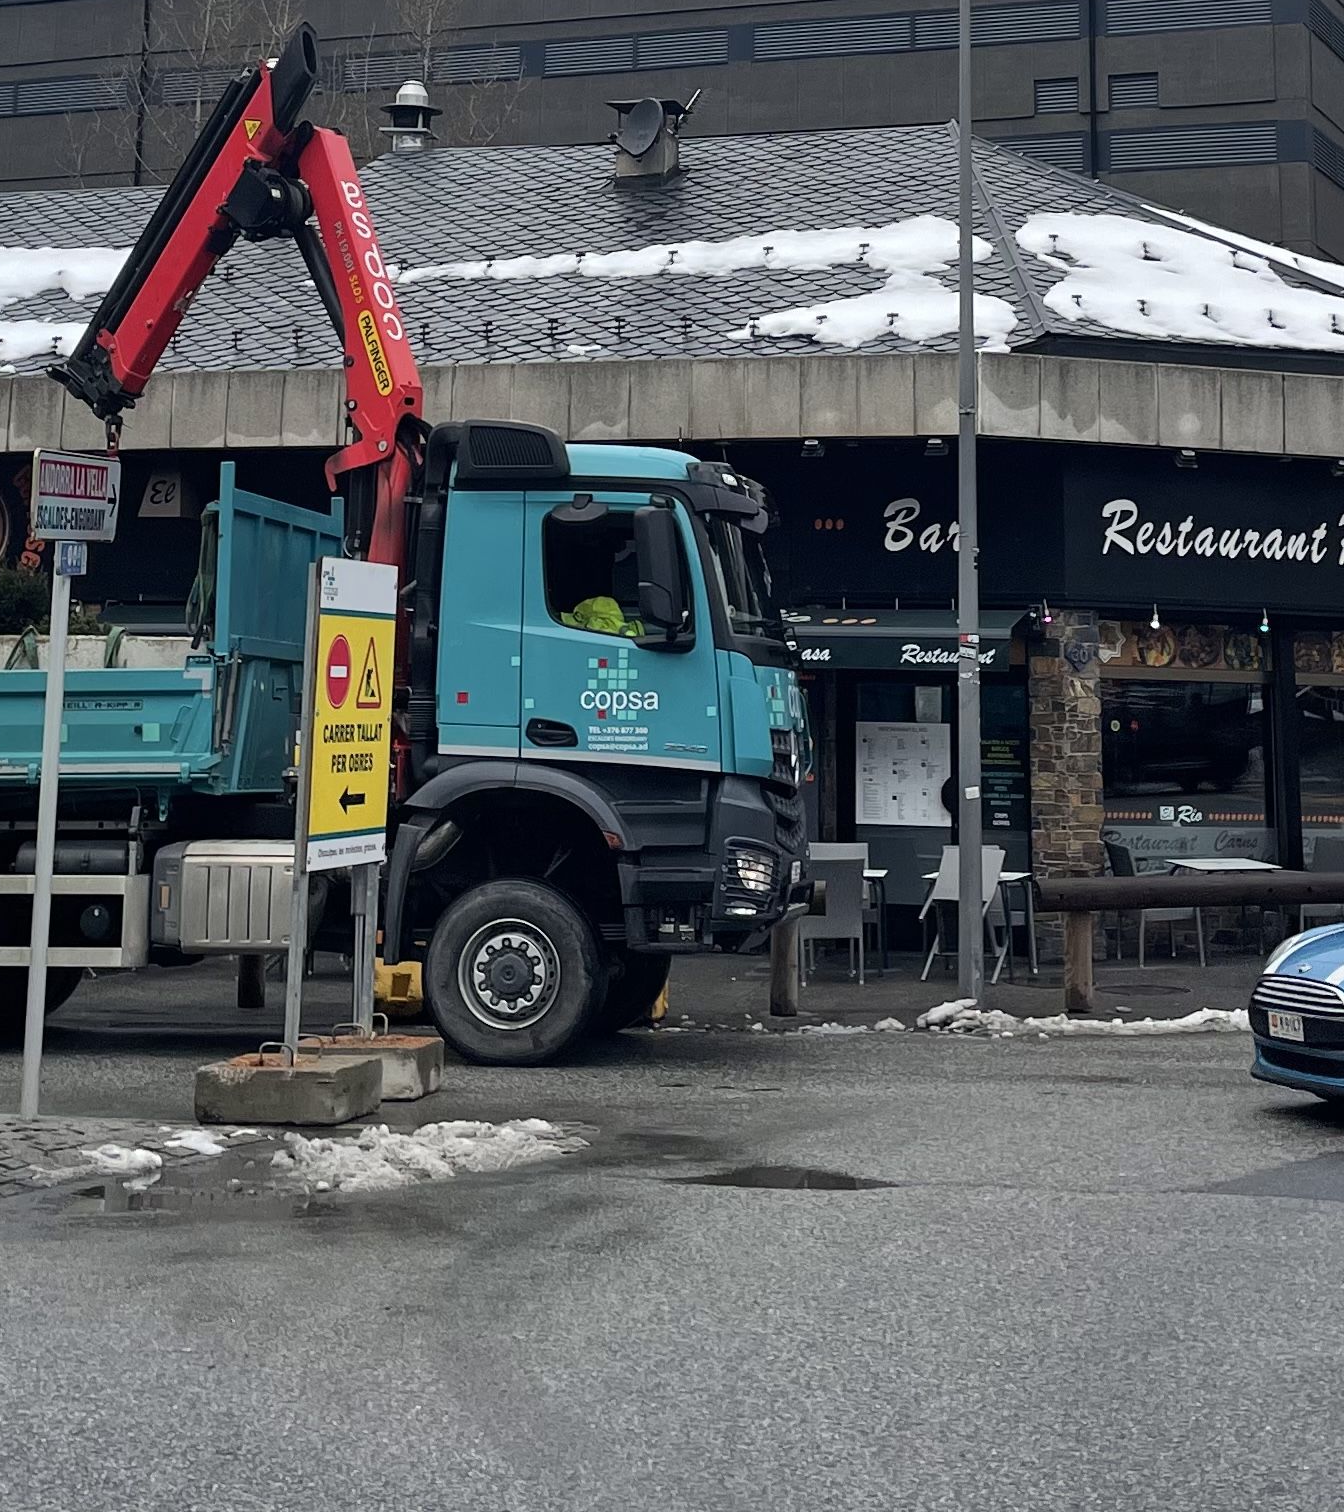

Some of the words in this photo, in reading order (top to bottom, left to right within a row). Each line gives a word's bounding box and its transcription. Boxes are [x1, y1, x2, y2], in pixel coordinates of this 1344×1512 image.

[340, 179, 404, 341] copsa
[360, 314, 391, 392] PALFINGER
[40, 462, 75, 495] ANDORRA
[76, 466, 86, 496] LA
[87, 467, 108, 498] VELLA
[150, 480, 176, 505] El
[1101, 498, 1328, 563] Restaurant
[900, 643, 996, 664] Restaunt
[580, 689, 659, 716] copsa
[323, 724, 355, 744] CARRER
[357, 723, 383, 742] TALLAT
[331, 753, 347, 773] PER
[349, 753, 374, 773] OBRES
[1177, 805, 1203, 824] Rio
